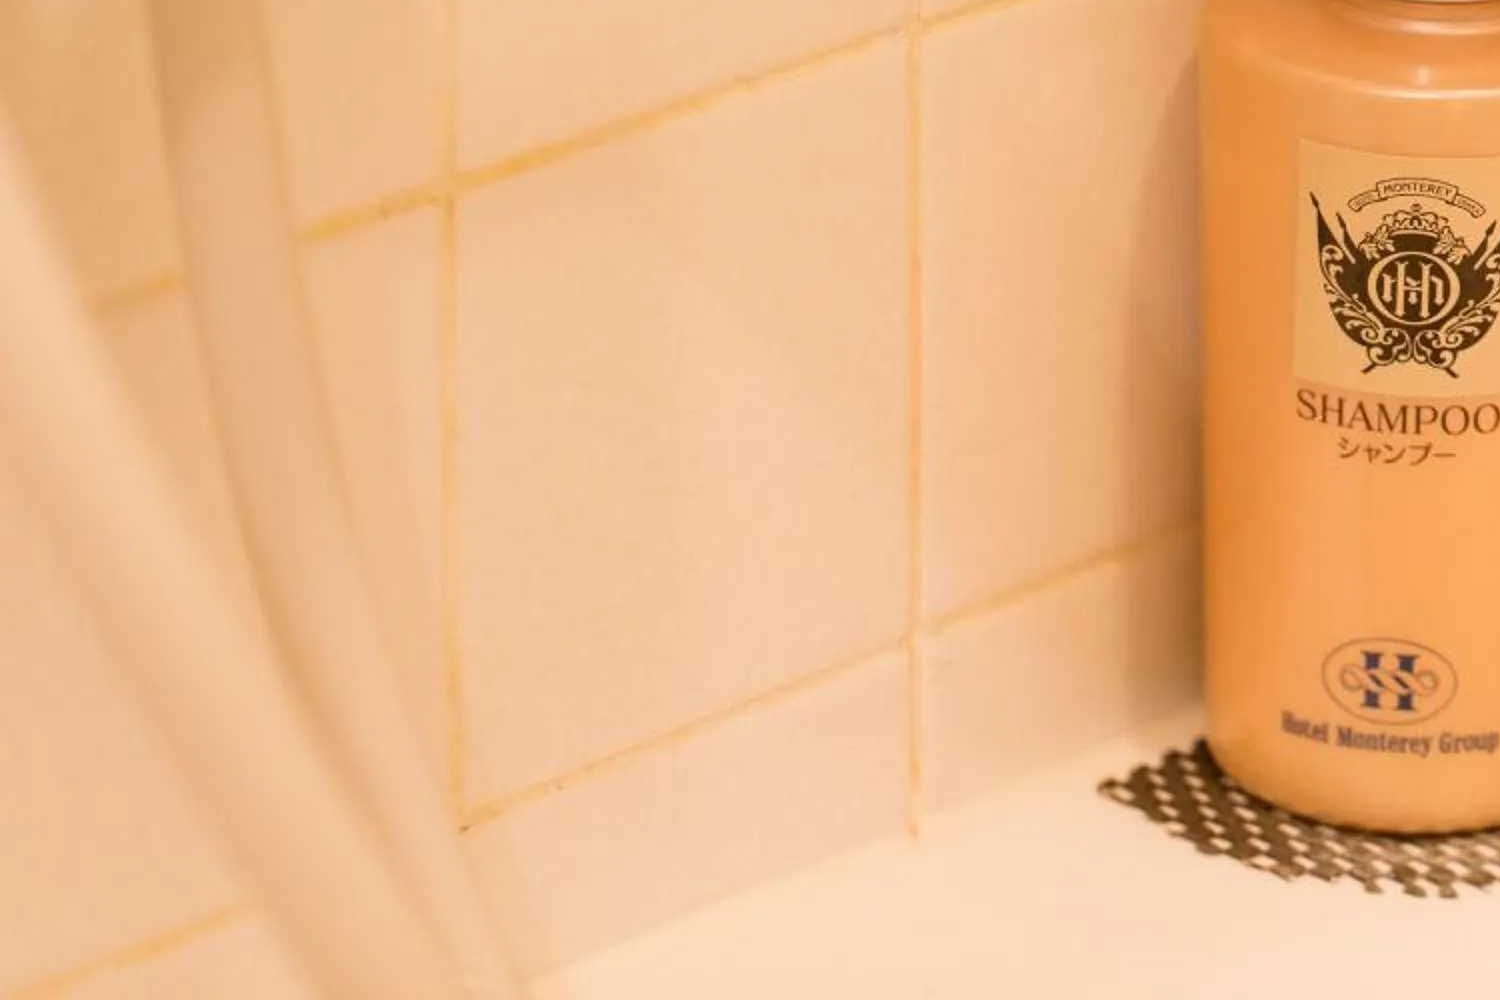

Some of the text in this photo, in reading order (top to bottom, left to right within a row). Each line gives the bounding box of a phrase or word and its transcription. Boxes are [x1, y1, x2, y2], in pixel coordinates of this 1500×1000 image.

[1383, 182, 1453, 197] MONTEREY
[1296, 388, 1500, 436] SHAMPOO
[1281, 710, 1500, 758] Hotel Monterey Group
